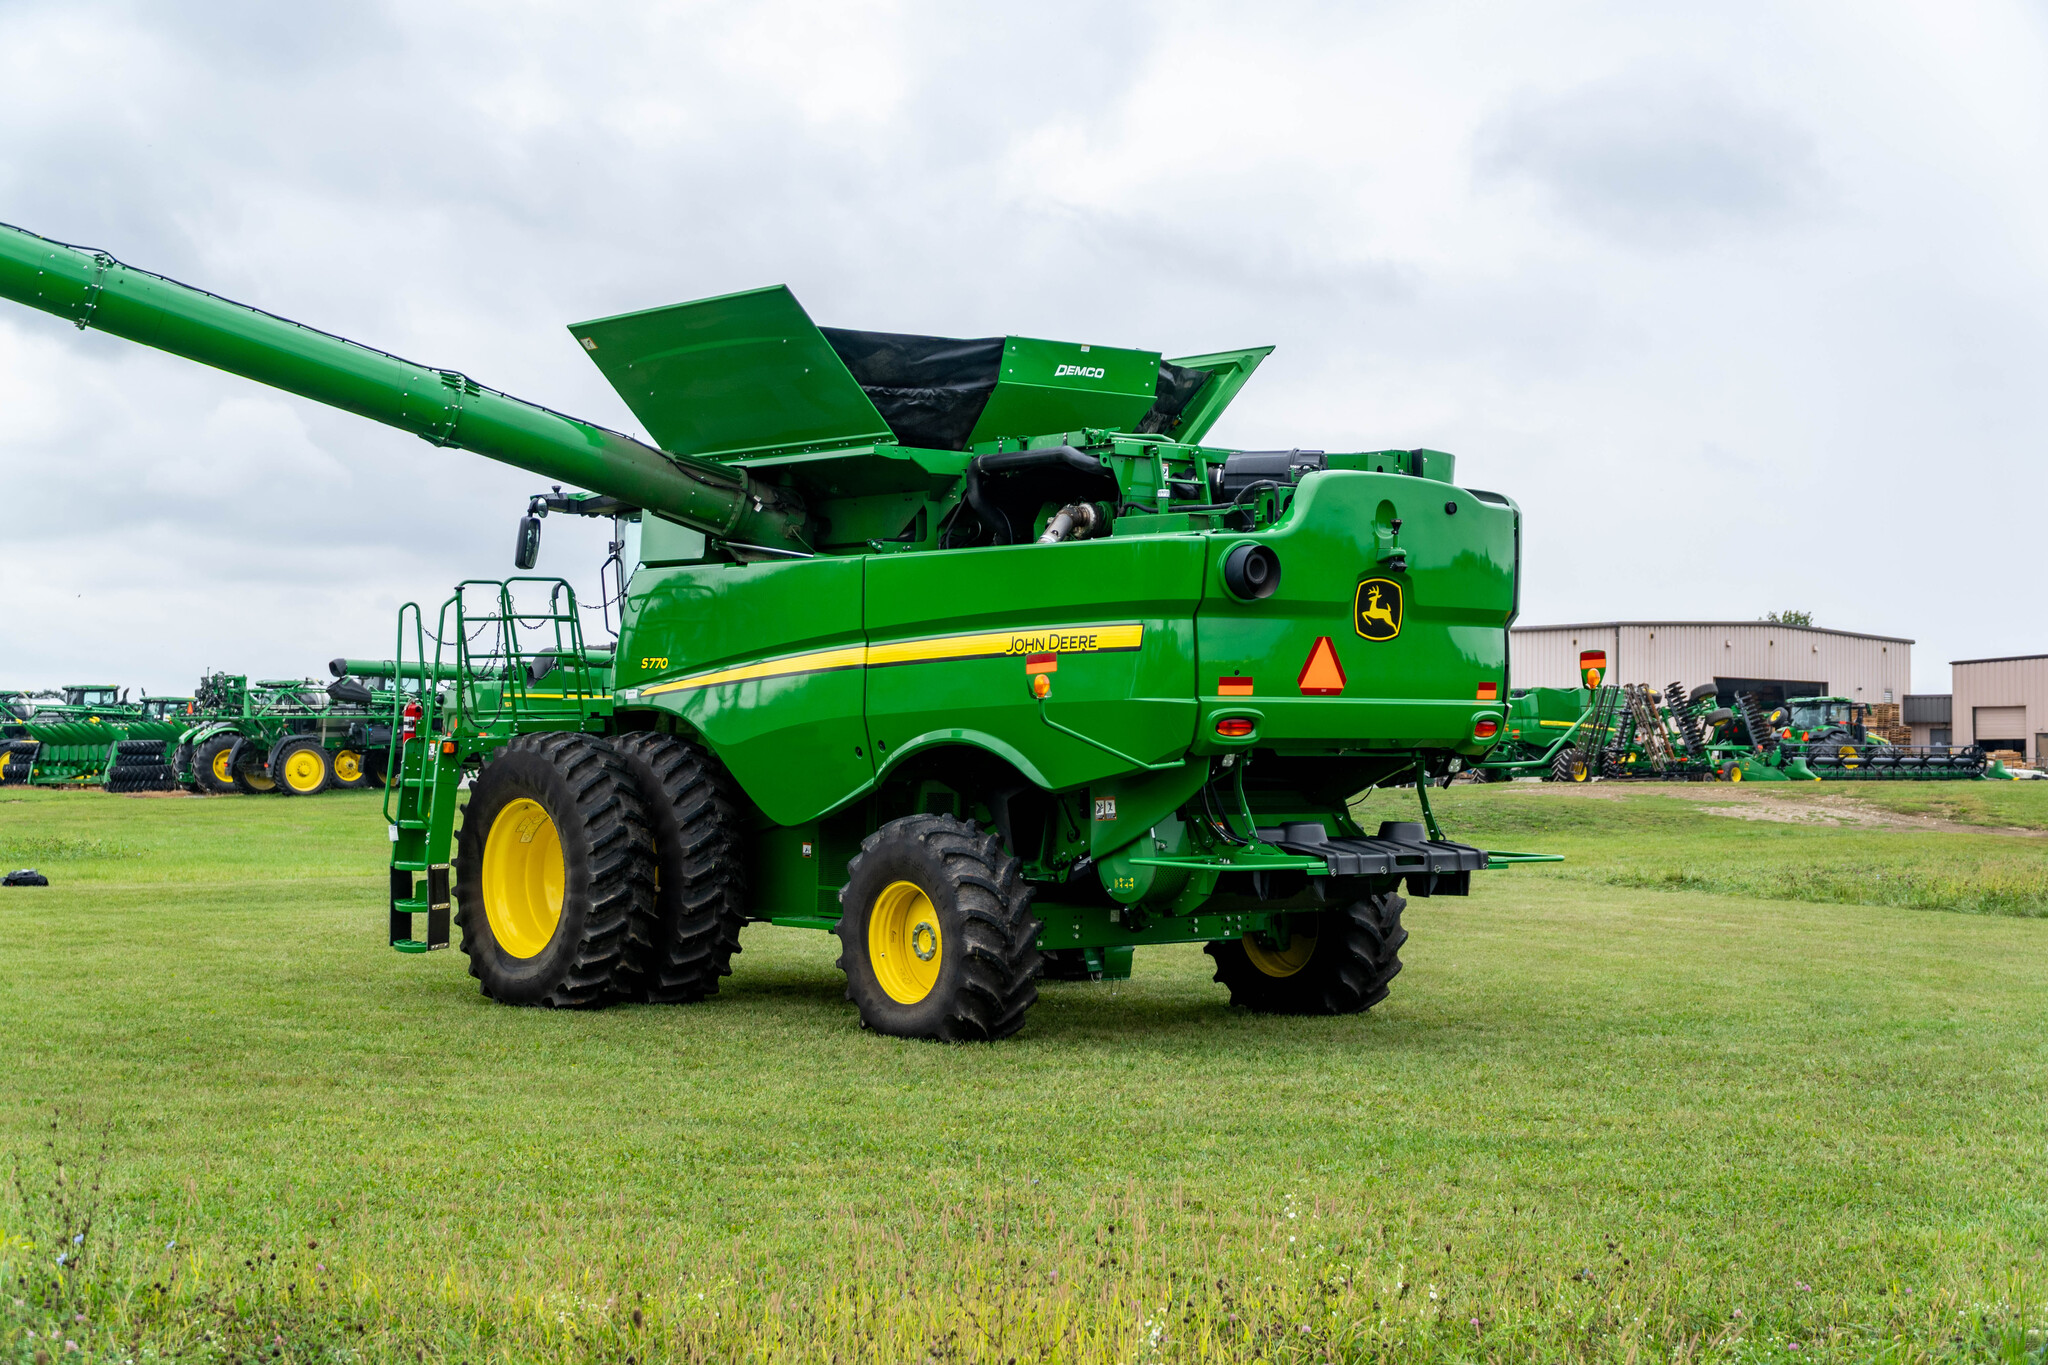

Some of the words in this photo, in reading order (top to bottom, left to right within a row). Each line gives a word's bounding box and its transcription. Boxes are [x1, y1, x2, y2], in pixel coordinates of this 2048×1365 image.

[1054, 364, 1105, 379] DEMCO
[1006, 635, 1045, 652] JOHN
[1049, 633, 1098, 650] DEERE
[641, 657, 669, 670] S770
